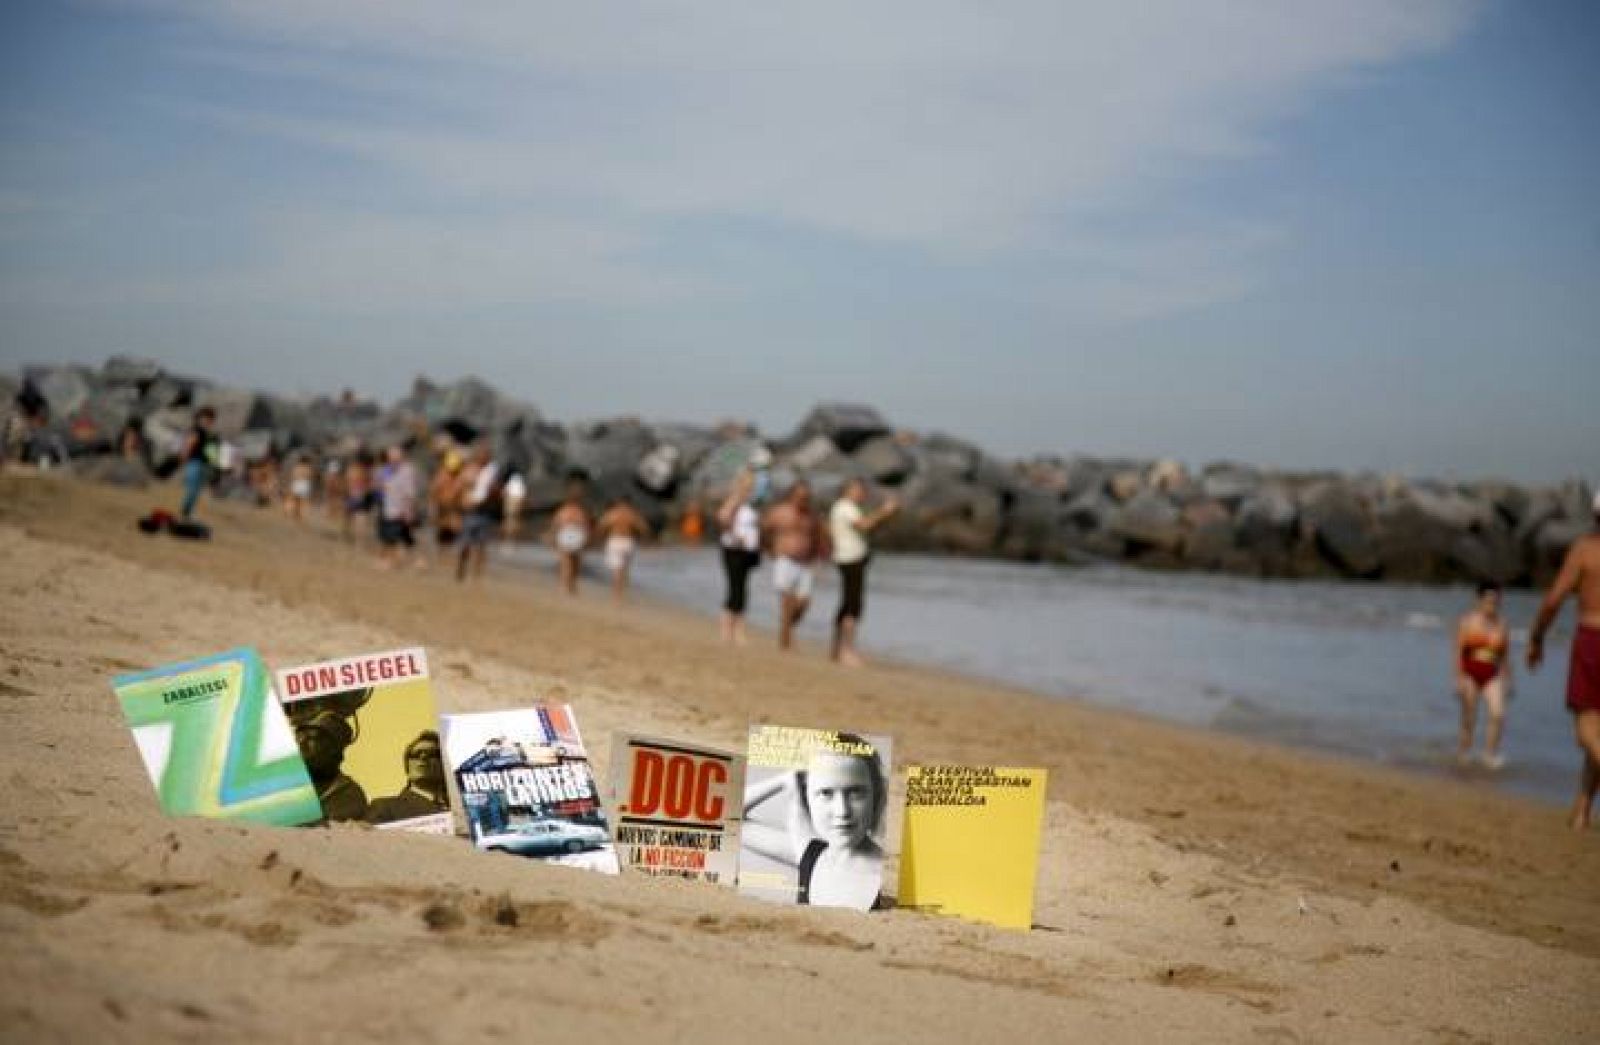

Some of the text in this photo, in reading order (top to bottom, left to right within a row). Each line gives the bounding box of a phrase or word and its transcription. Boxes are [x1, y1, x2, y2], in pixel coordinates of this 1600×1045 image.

[285, 652, 421, 695] DON SIEGEL
[906, 777, 926, 787] DE
[928, 777, 955, 787] SAN
[937, 767, 995, 777] FESTIVAL
[617, 827, 658, 845] NUEVOS
[660, 830, 706, 849] CAMINOS
[629, 845, 641, 865] LA
[646, 847, 658, 866] NO
